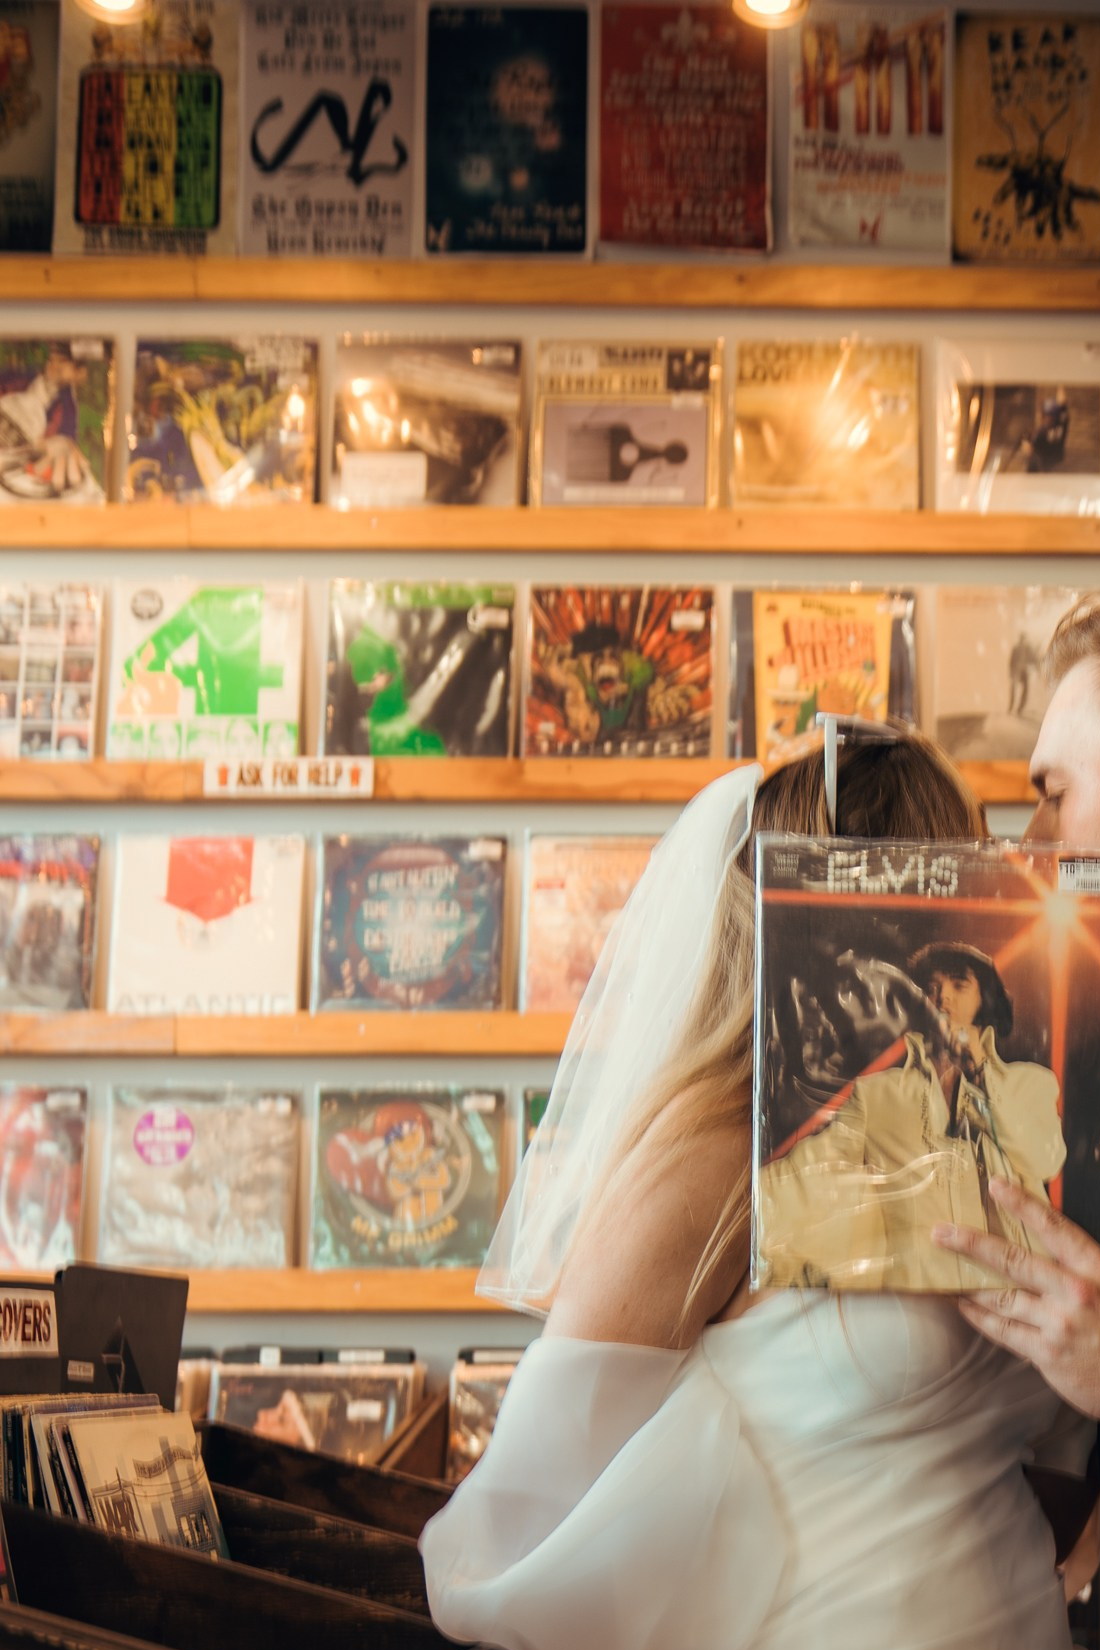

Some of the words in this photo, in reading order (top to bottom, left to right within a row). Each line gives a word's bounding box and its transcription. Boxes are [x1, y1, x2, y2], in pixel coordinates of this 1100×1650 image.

[237, 762, 263, 787] ASK
[272, 762, 298, 787] FOR
[307, 762, 343, 787] HELP
[827, 853, 959, 898] ELVIS
[0, 1297, 52, 1343] OVERS
